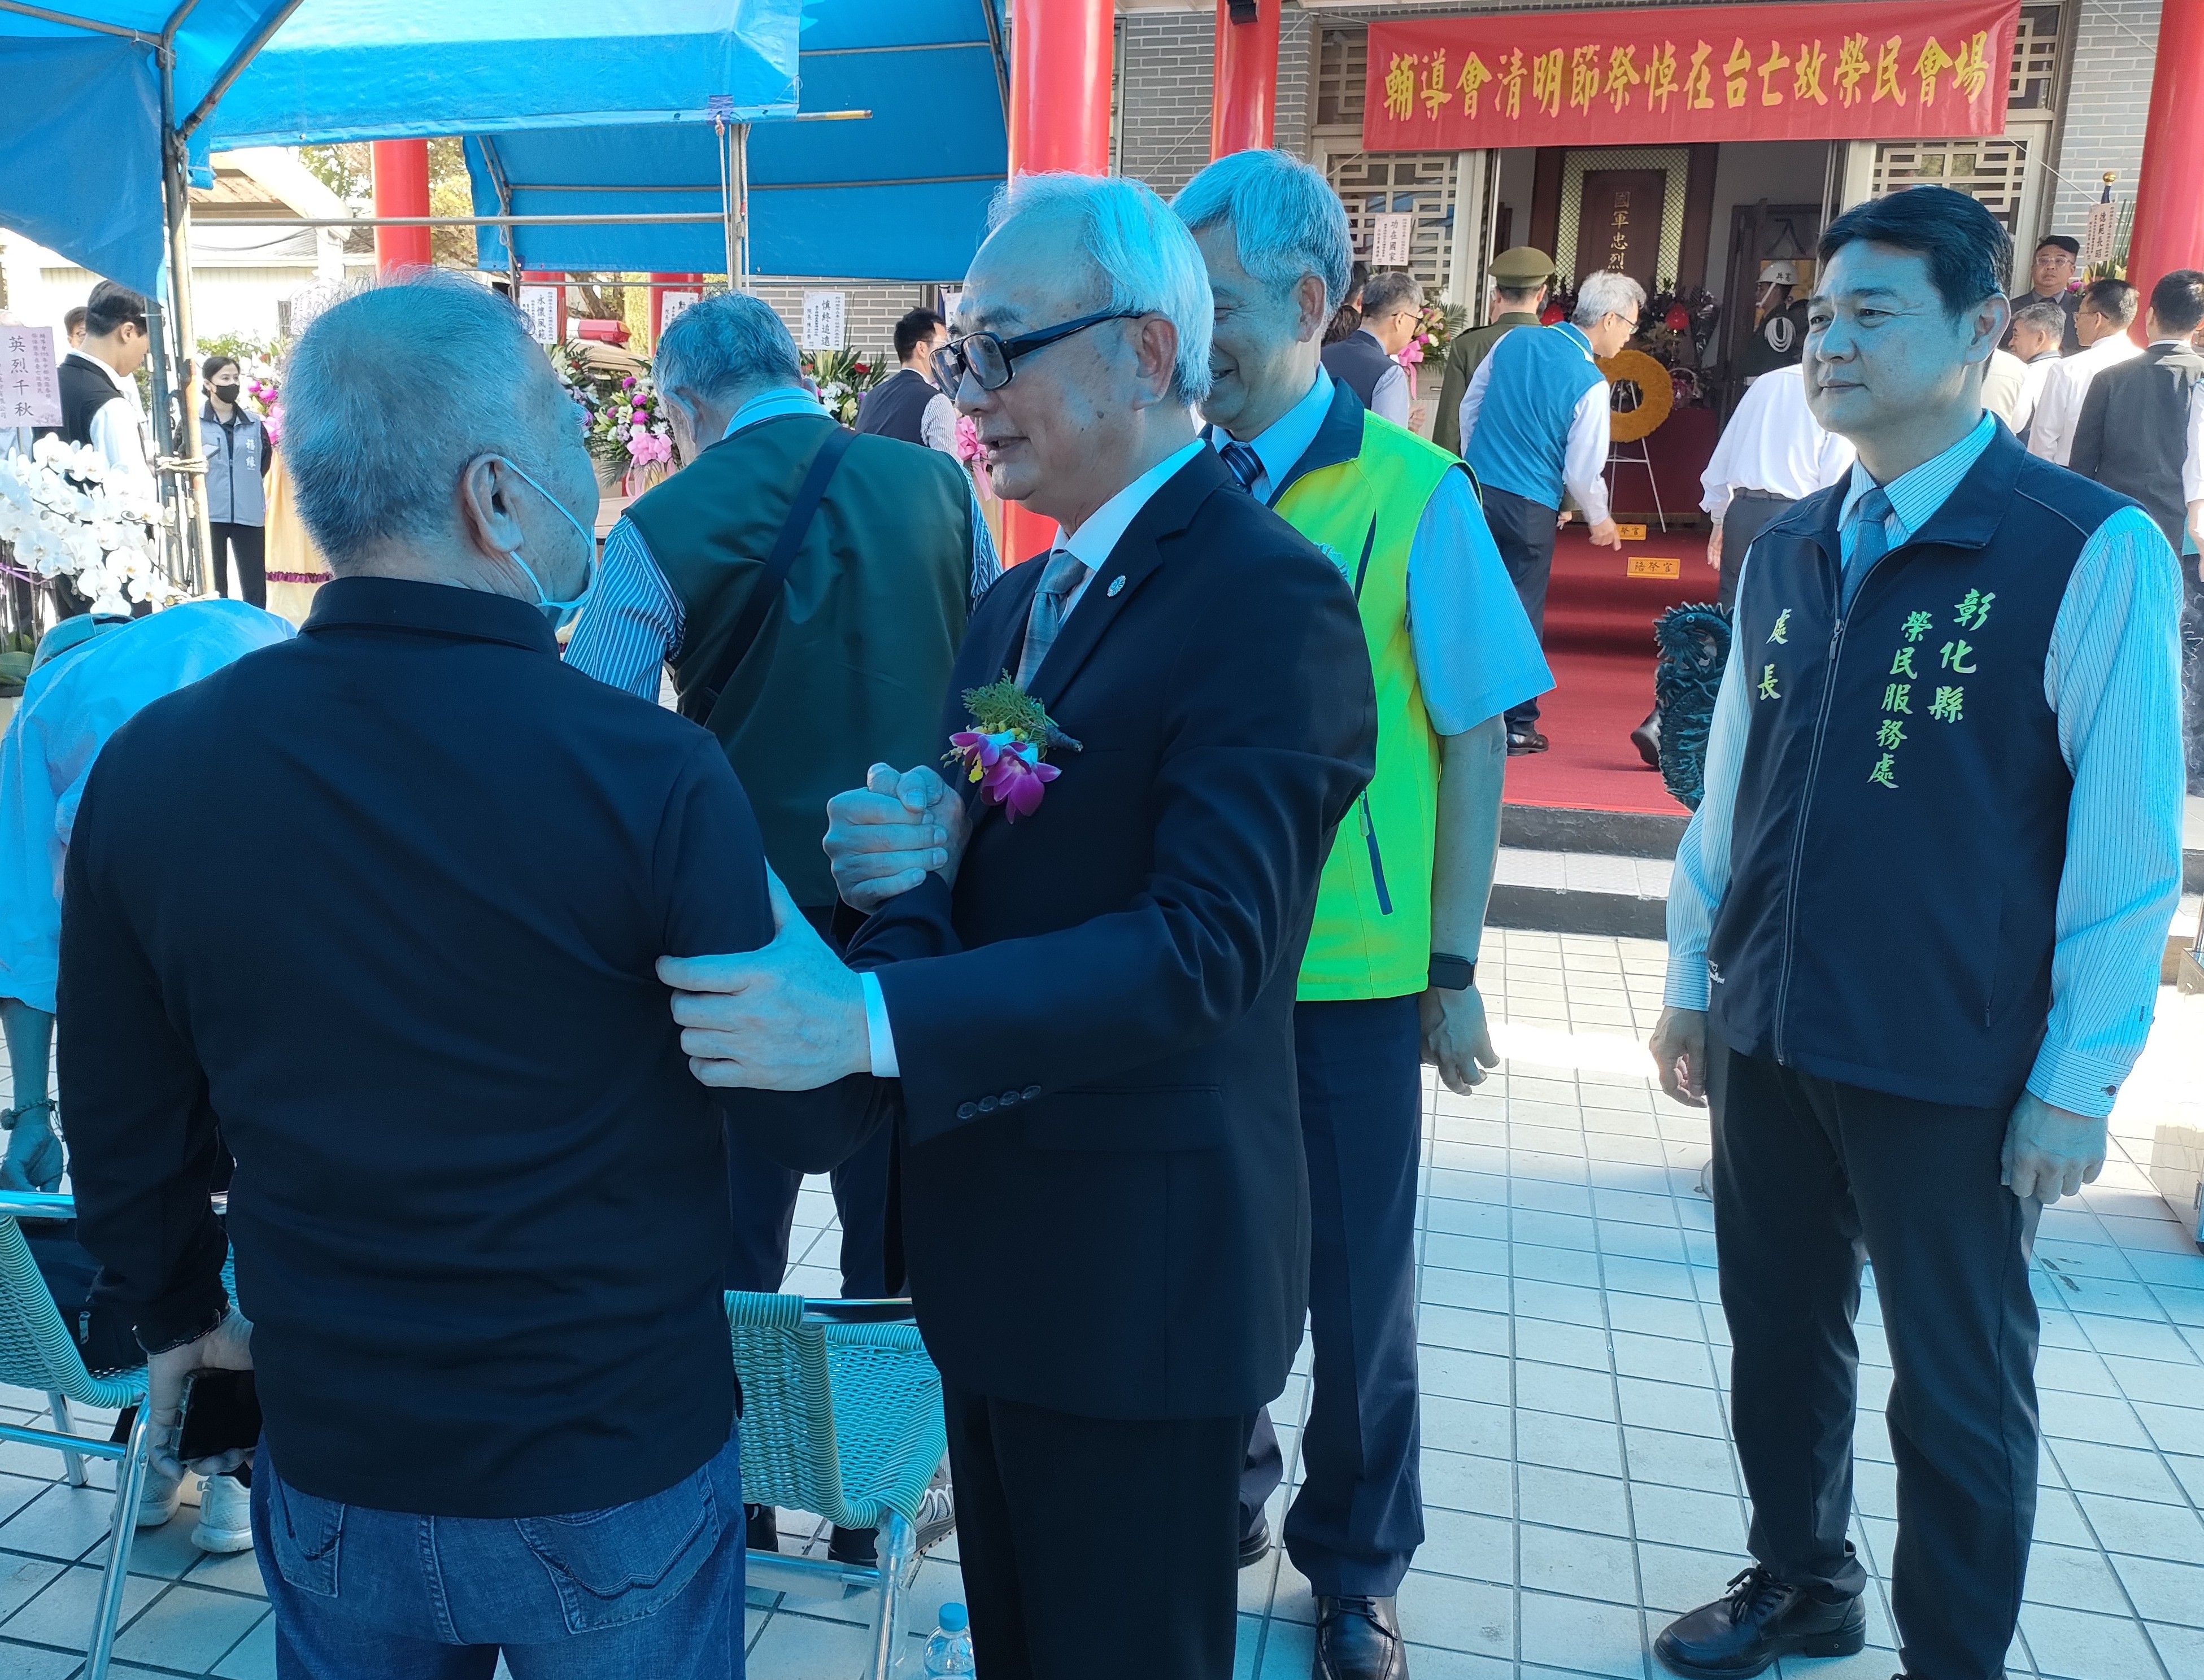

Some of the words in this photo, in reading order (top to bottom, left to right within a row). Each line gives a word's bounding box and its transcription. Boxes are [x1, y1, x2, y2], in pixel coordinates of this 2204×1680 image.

[1383, 30, 1990, 122] 輔導會清明節祭悼在台亡故榮民會場
[1389, 219, 1399, 262] 功在國家
[1608, 191, 1631, 275] 國軍忠烈
[821, 299, 831, 347] 慎終追遠
[8, 335, 34, 417] 英烈千秋
[1635, 561, 1673, 572] 陪祭官
[1757, 609, 1792, 701] 處長
[1927, 588, 1996, 723] 彰化縣
[1866, 610, 1933, 789] 榮民服務處
